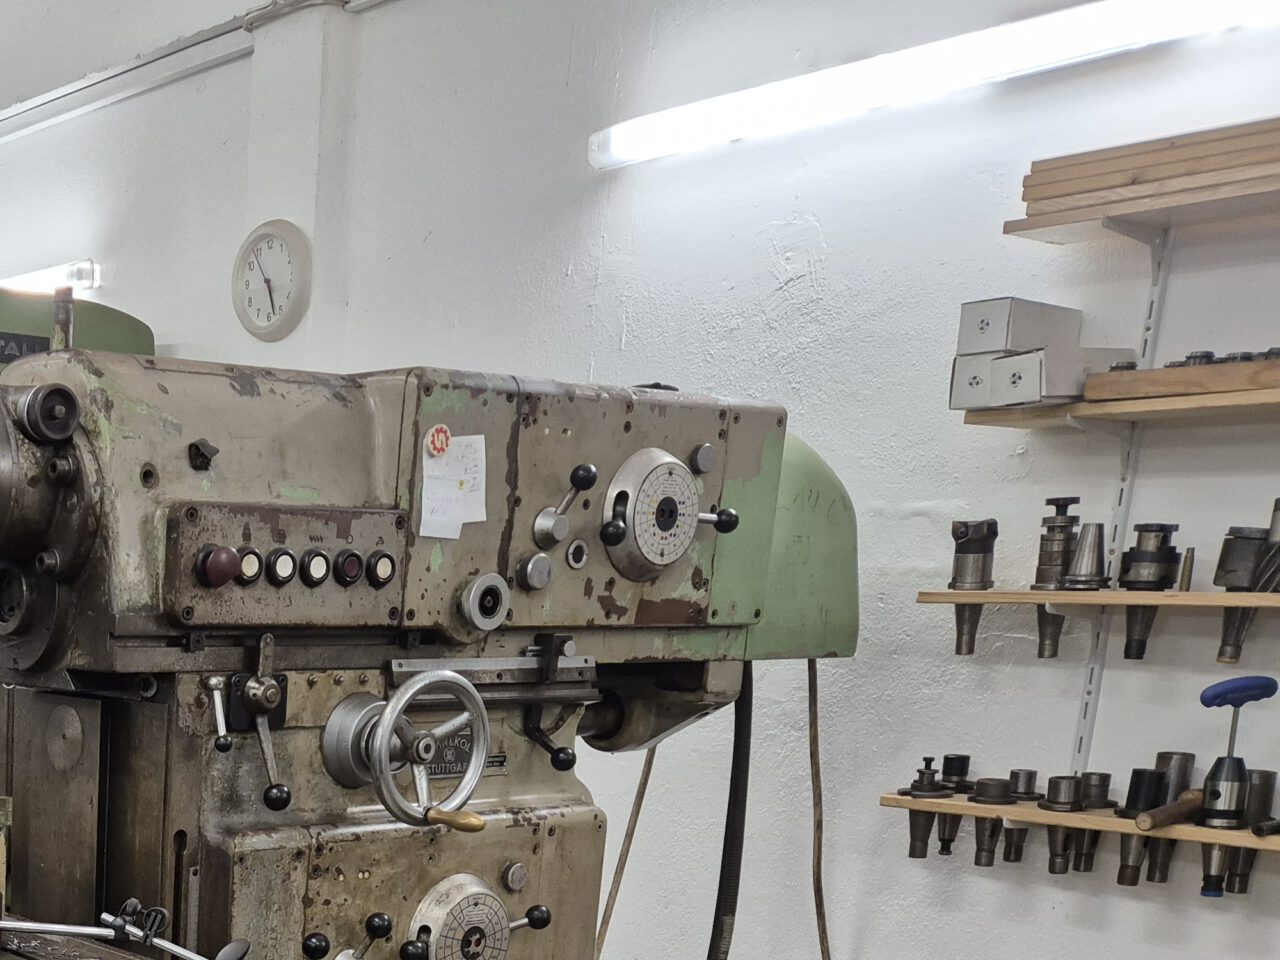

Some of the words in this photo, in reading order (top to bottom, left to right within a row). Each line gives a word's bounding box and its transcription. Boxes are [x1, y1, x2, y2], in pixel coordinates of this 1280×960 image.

[266, 239, 274, 249] 12
[256, 247, 262, 256] 11
[248, 261, 255, 271] 10
[244, 279, 250, 289] 9
[247, 297, 253, 307] 8
[256, 308, 261, 318] 7
[266, 312, 272, 322] 6
[425, 763, 468, 774] STUTTGAR
